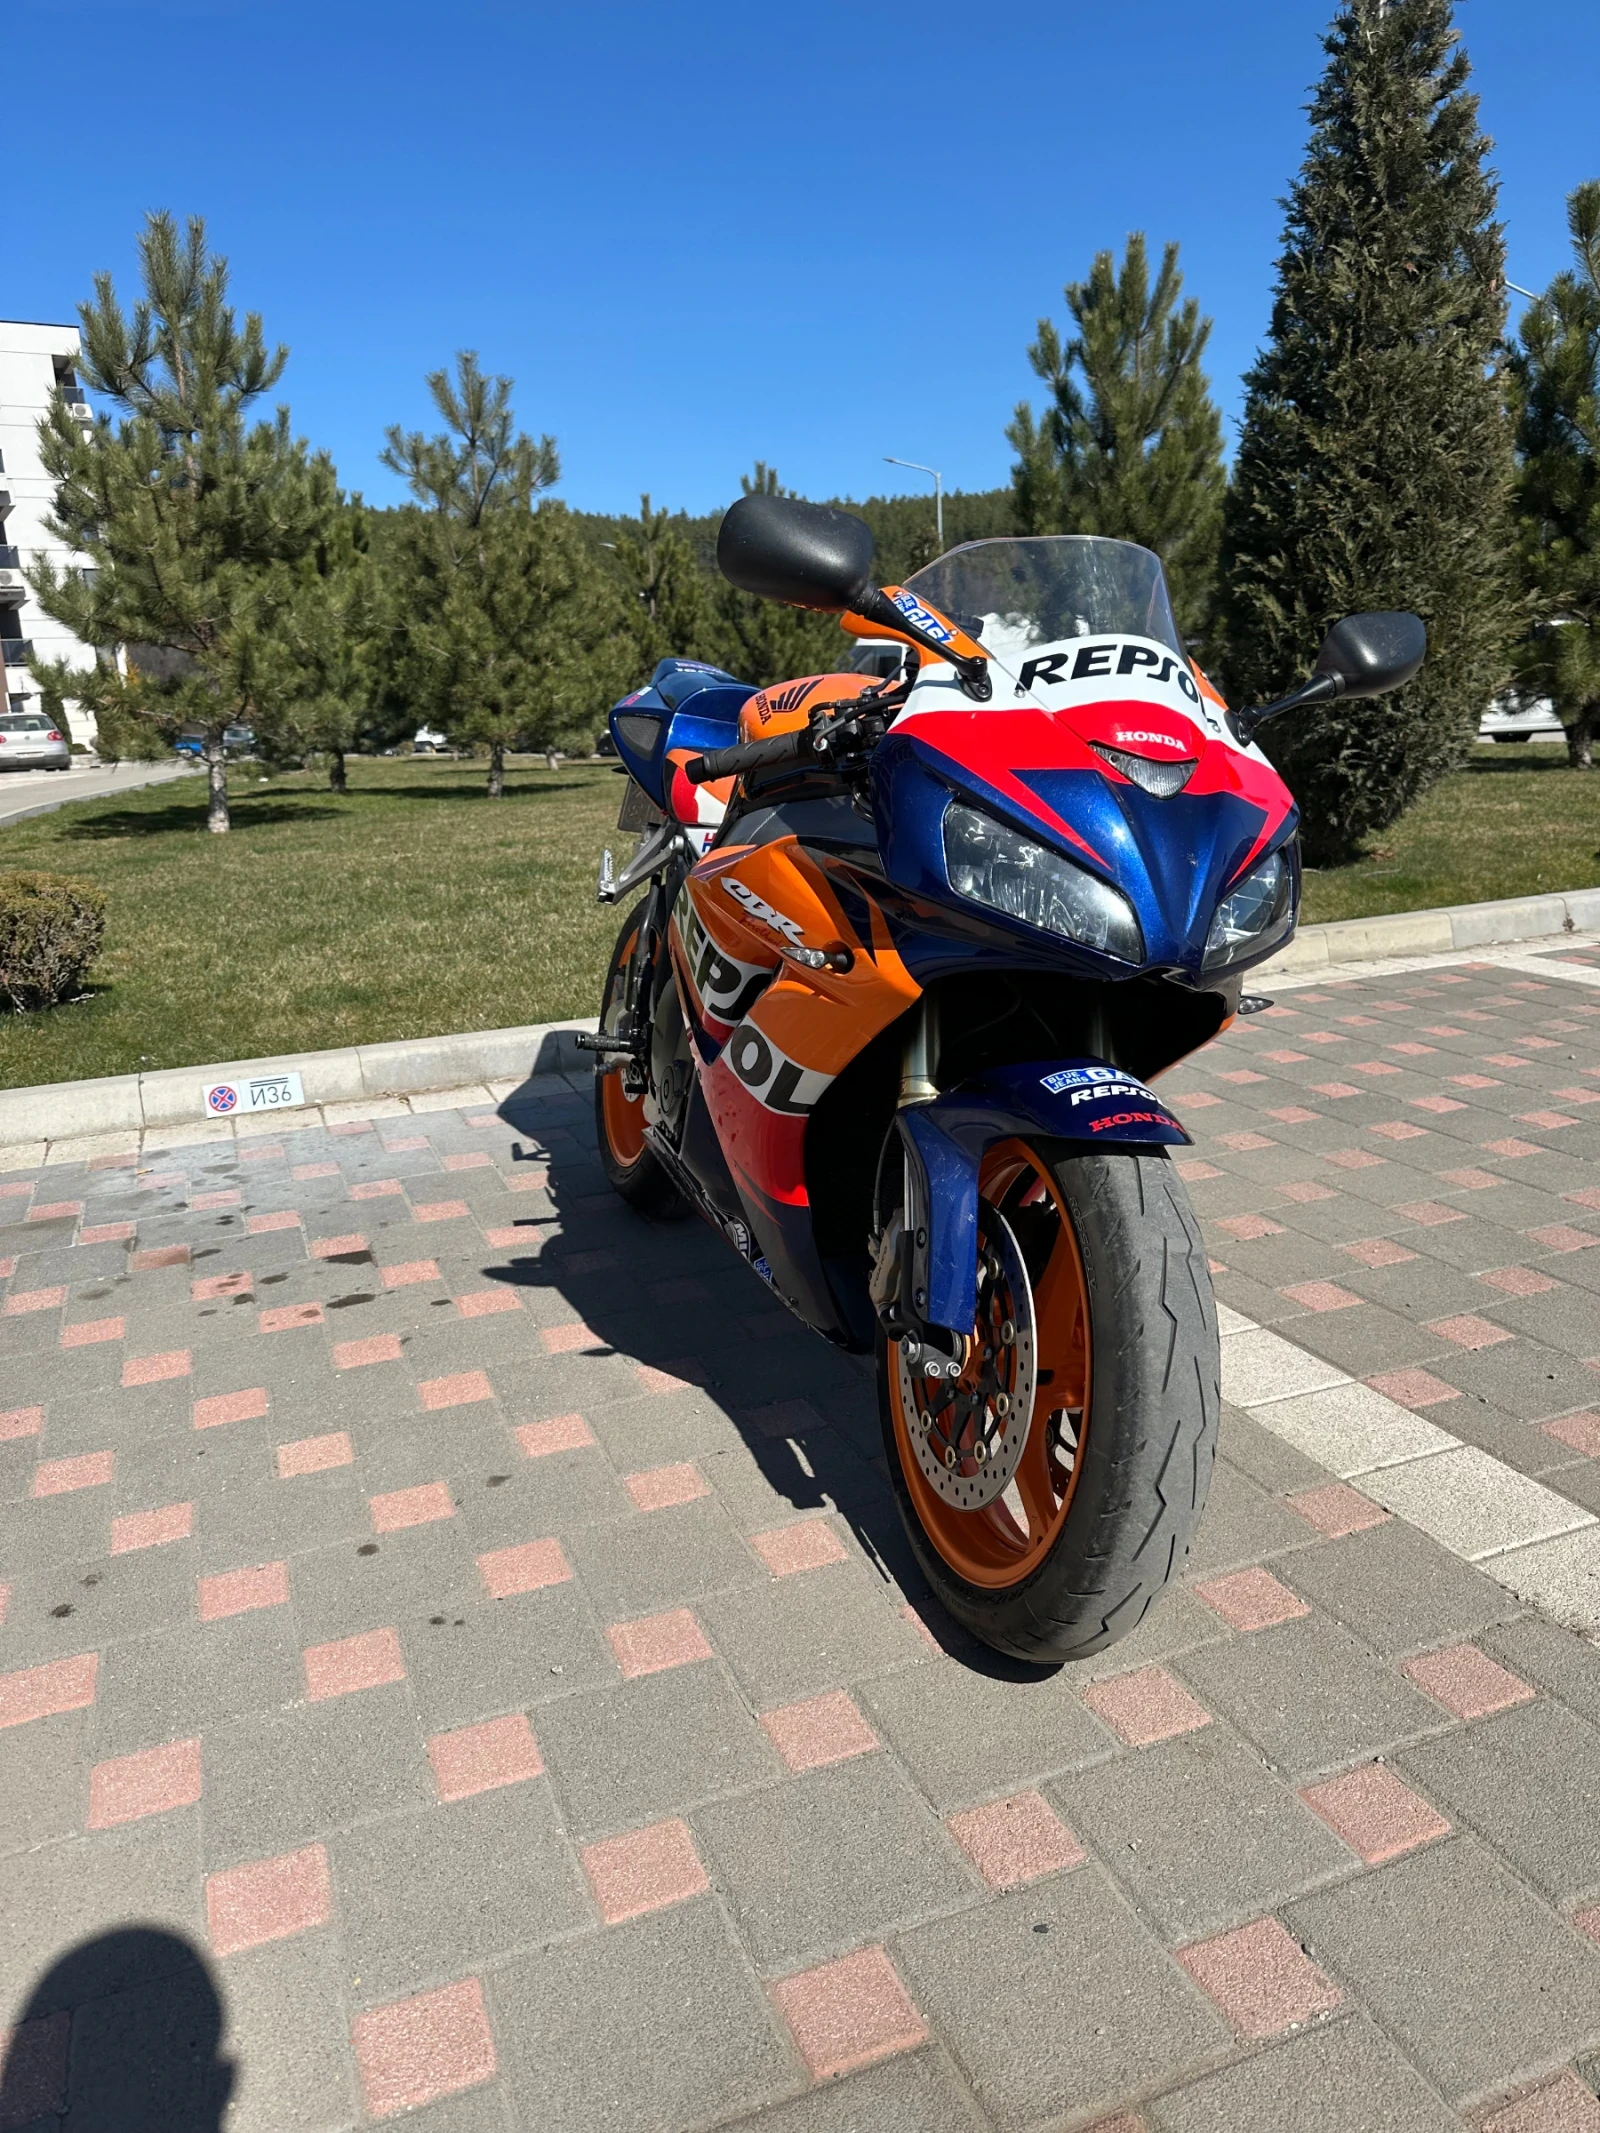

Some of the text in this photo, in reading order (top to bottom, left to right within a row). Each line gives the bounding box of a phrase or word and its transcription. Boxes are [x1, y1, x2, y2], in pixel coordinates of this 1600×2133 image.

[754, 692, 773, 726] HONDA
[1116, 731, 1187, 753] HONDA
[721, 876, 806, 948] CBR
[1048, 1070, 1081, 1084] BLUE
[1053, 1076, 1089, 1091] JEANS
[250, 1084, 292, 1107] И36
[1088, 1112, 1188, 1135] HONDA
[1069, 1196, 1093, 1259] ROSSO
